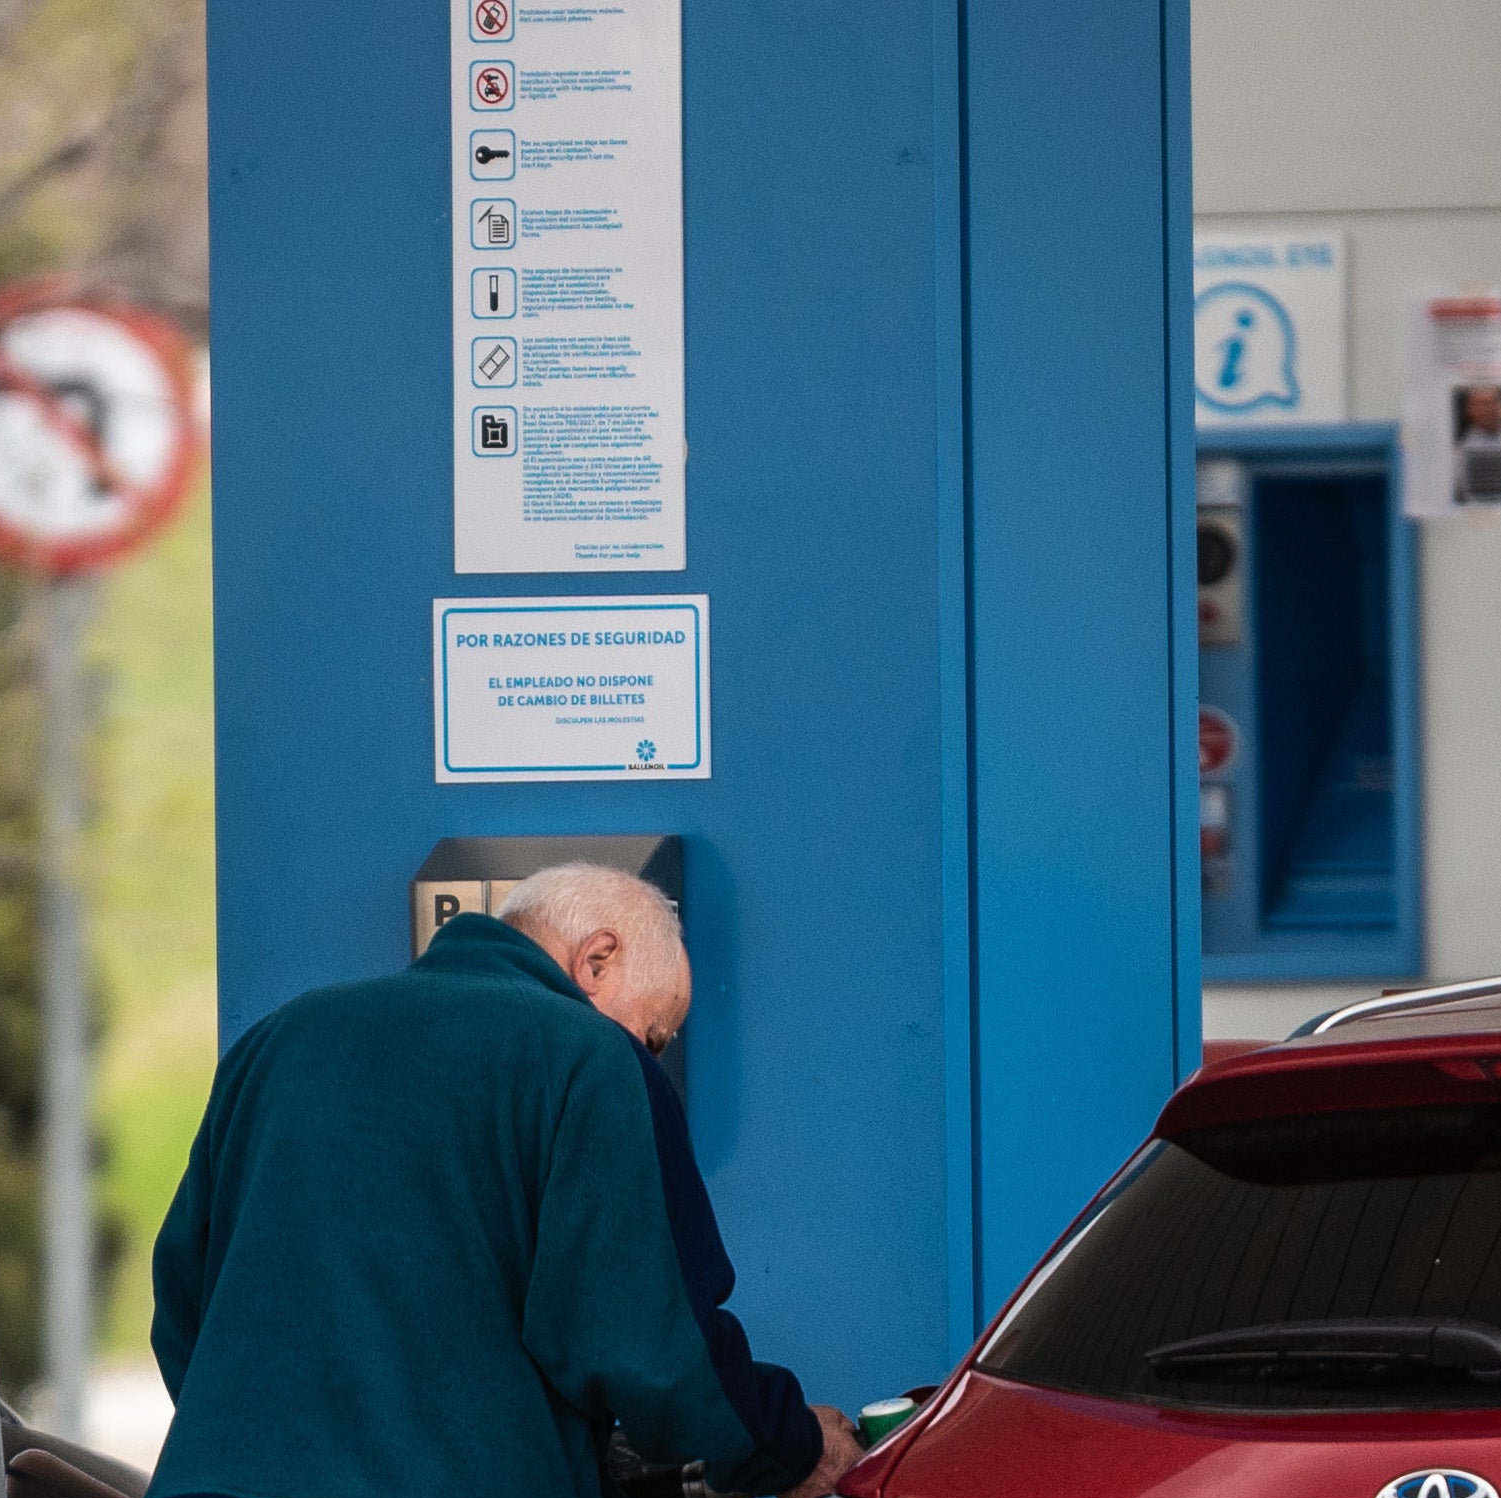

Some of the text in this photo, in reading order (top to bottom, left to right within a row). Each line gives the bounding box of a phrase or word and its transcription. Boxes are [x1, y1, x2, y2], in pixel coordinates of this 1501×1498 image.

[456, 630, 686, 648] POR RAZONES DE SEGURIDAD
[488, 674, 654, 689] EL EMPLEADO NO DISPONE
[497, 693, 645, 707] DE CAMBIO DE BILLETES
[594, 716, 607, 724] LAS
